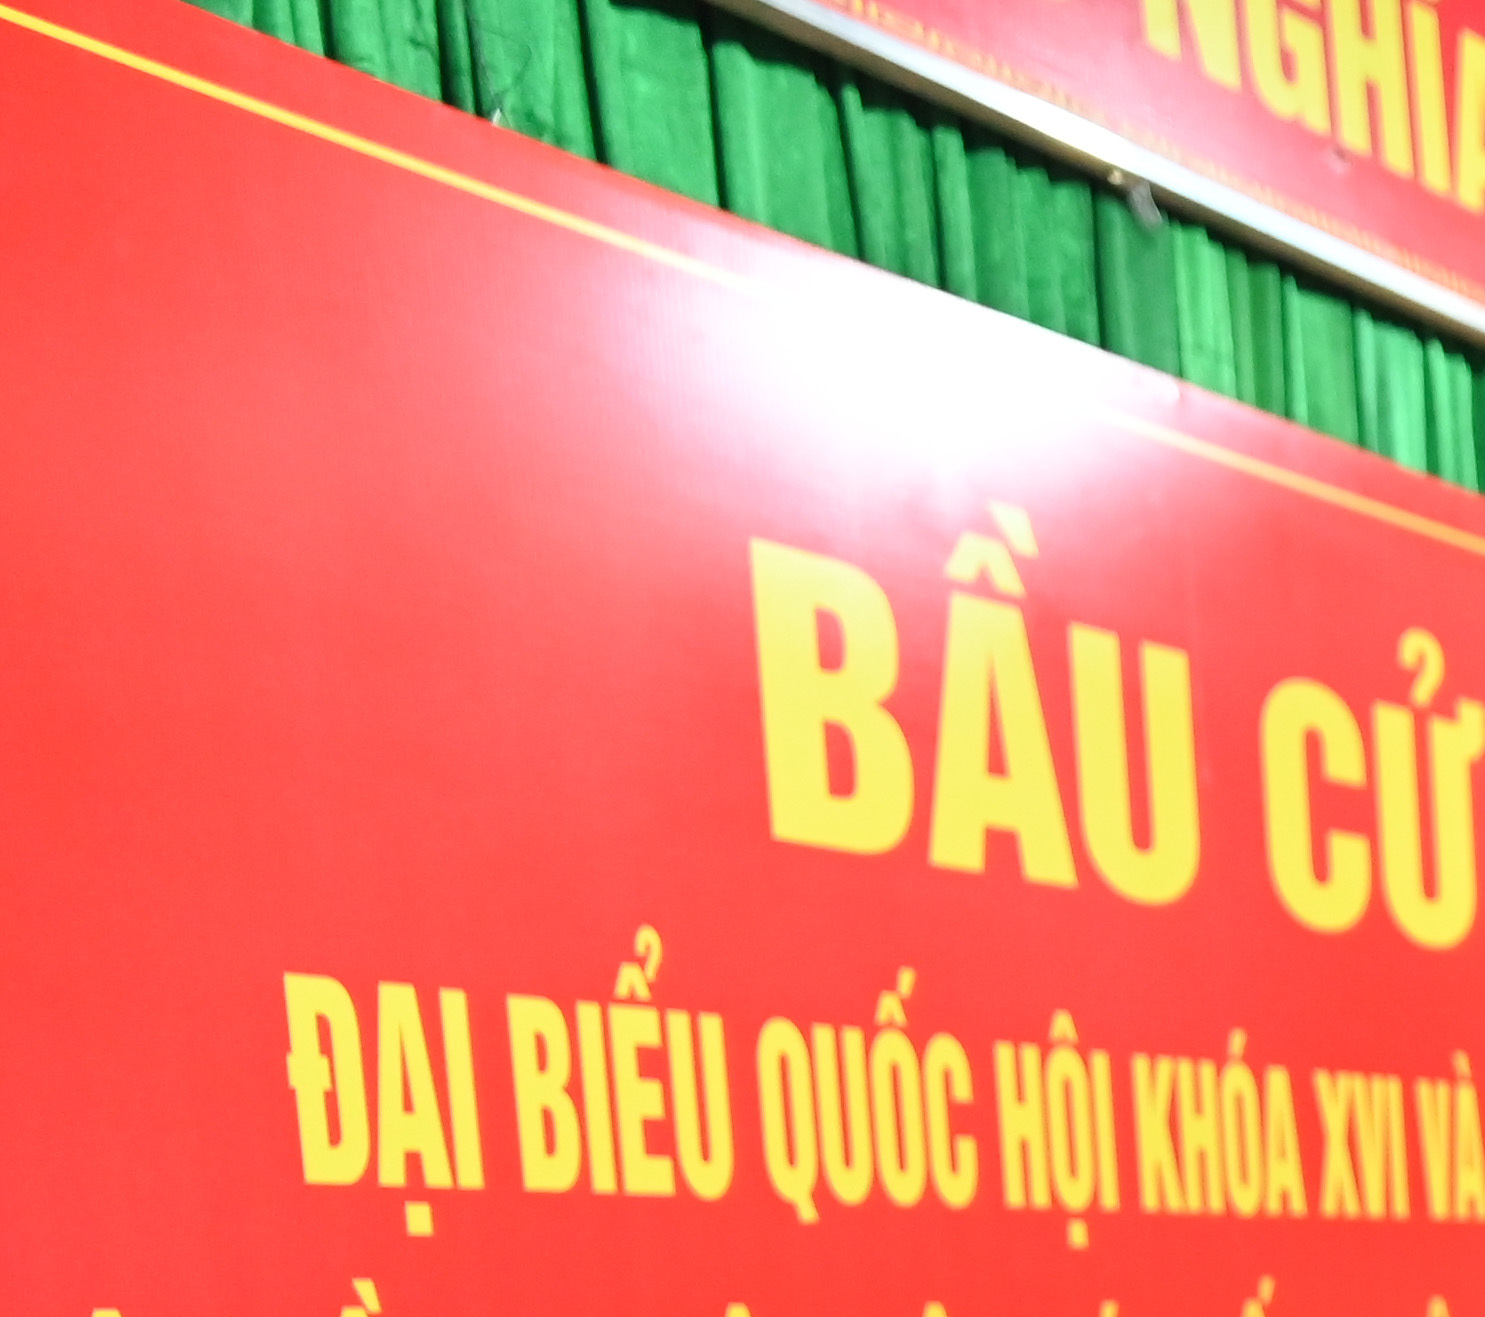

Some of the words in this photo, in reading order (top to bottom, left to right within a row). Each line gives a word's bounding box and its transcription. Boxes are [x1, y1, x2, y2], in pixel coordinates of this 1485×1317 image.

[750, 498, 1202, 908] BẦU
[282, 971, 486, 1238] ĐẠI
[506, 924, 736, 1202] BIỂU
[755, 966, 980, 1225] QUỐC
[993, 1008, 1121, 1250] HỘI
[1131, 1028, 1309, 1218] KHÓA
[1313, 1068, 1411, 1220] XVI
